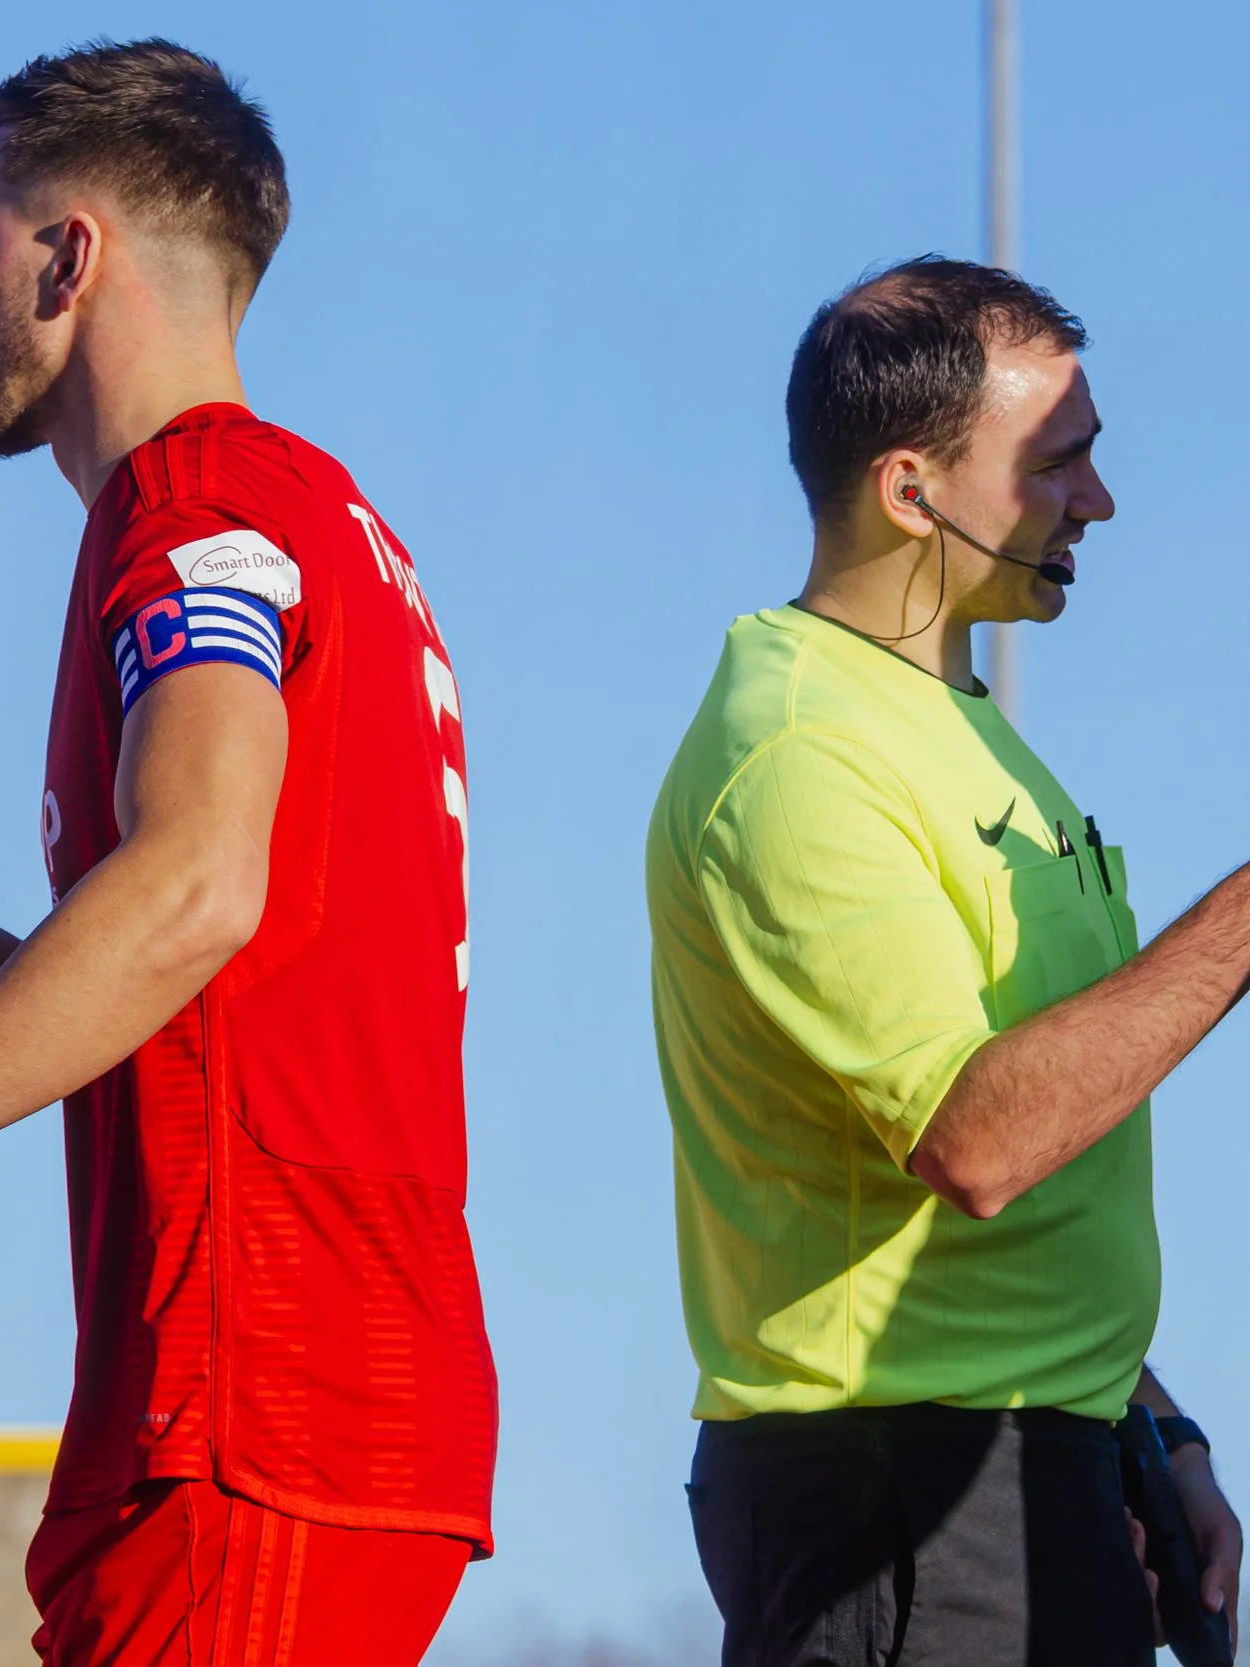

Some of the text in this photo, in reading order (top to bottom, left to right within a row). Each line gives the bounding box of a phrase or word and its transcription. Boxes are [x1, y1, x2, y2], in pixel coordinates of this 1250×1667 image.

[203, 556, 251, 573] Smart
[273, 587, 295, 605] Ltd
[136, 598, 187, 671] C
